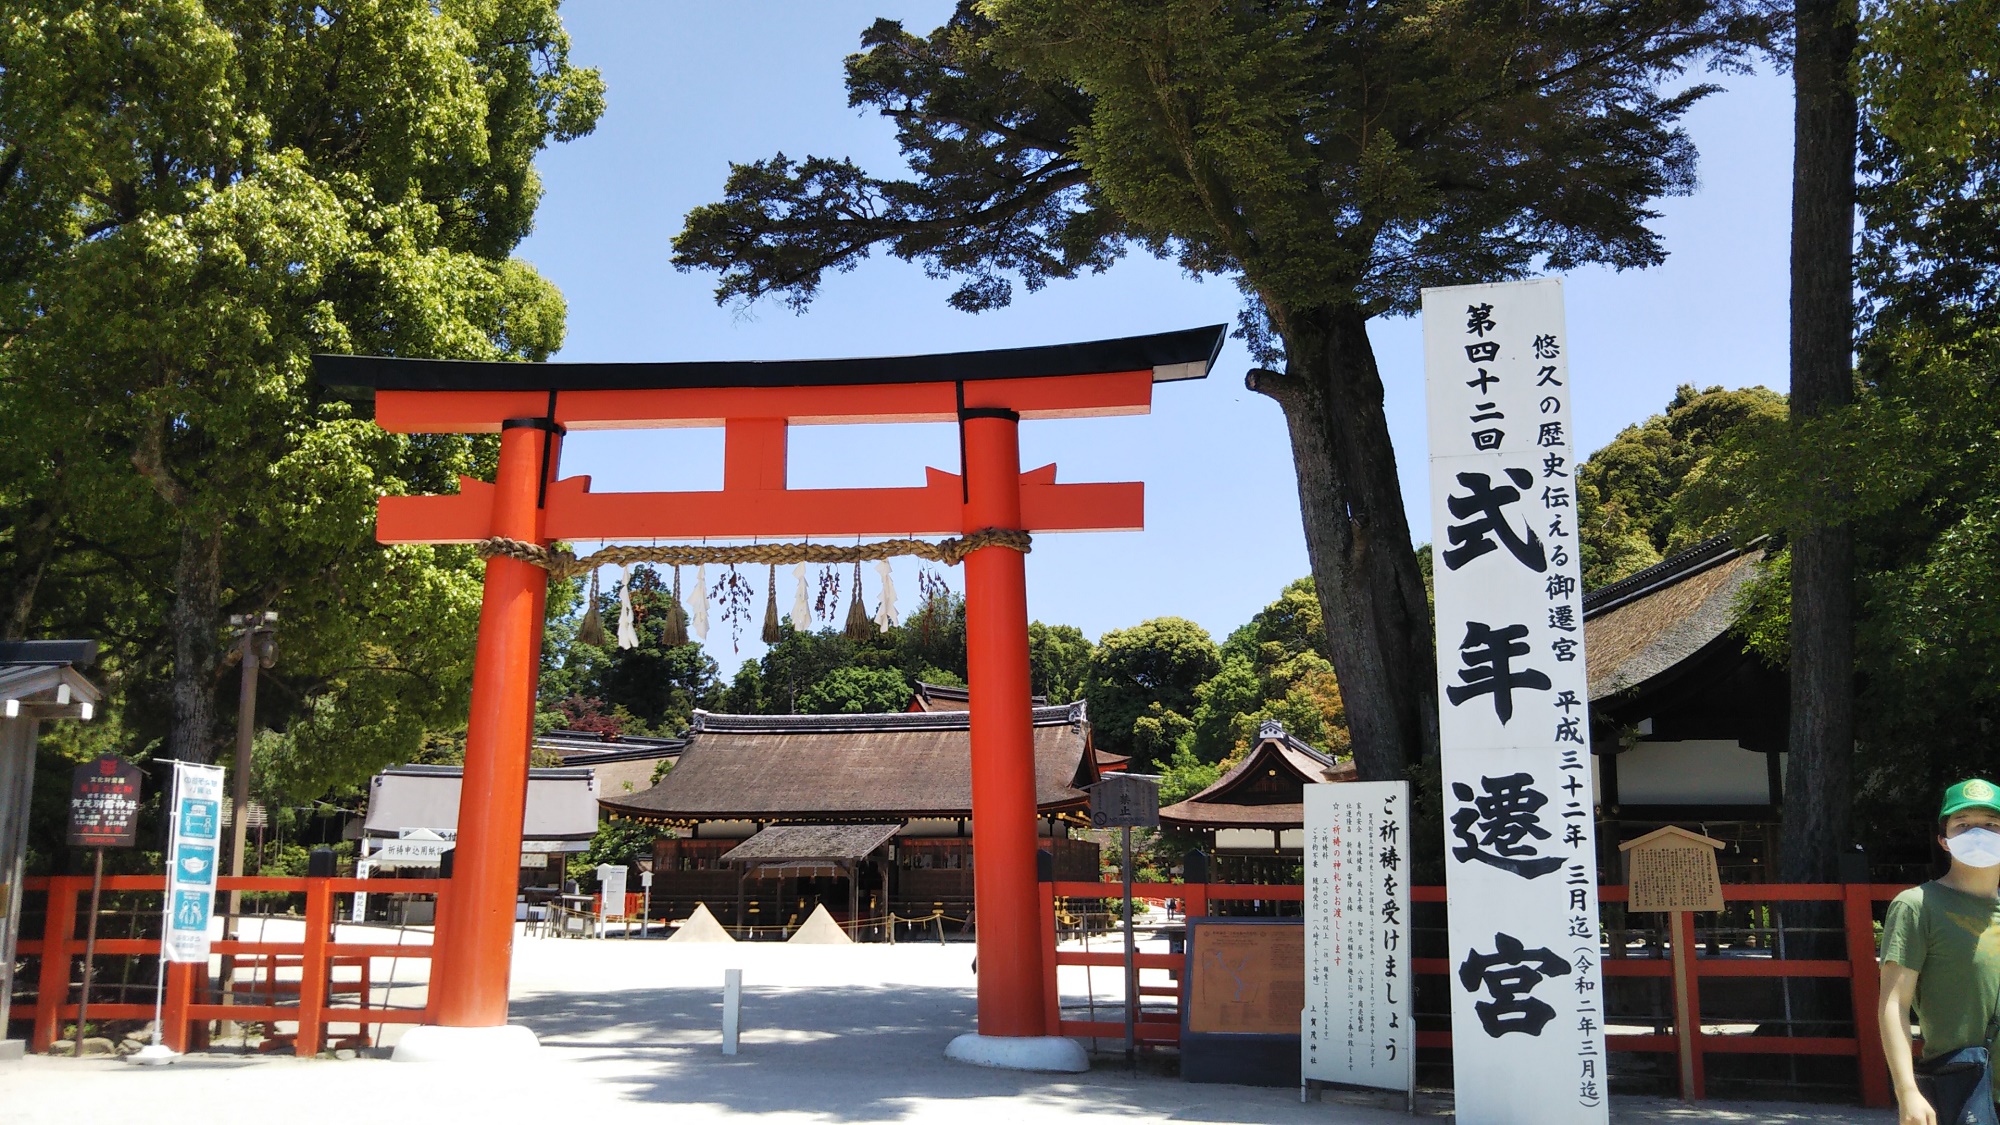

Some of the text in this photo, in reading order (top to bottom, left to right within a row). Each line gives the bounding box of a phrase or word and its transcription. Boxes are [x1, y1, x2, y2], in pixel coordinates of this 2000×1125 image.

[1532, 334, 1578, 662] 悠久の歴史伝える御遷宮
[1442, 302, 1572, 1039] 第四十二回 式年遷宮
[1553, 690, 1588, 850] 平成三十二年
[72, 799, 137, 809] 賀茂別雷神社
[387, 845, 447, 856] 祈祷申込用紙記
[1379, 795, 1402, 1061] ご祈祷を受けましょう
